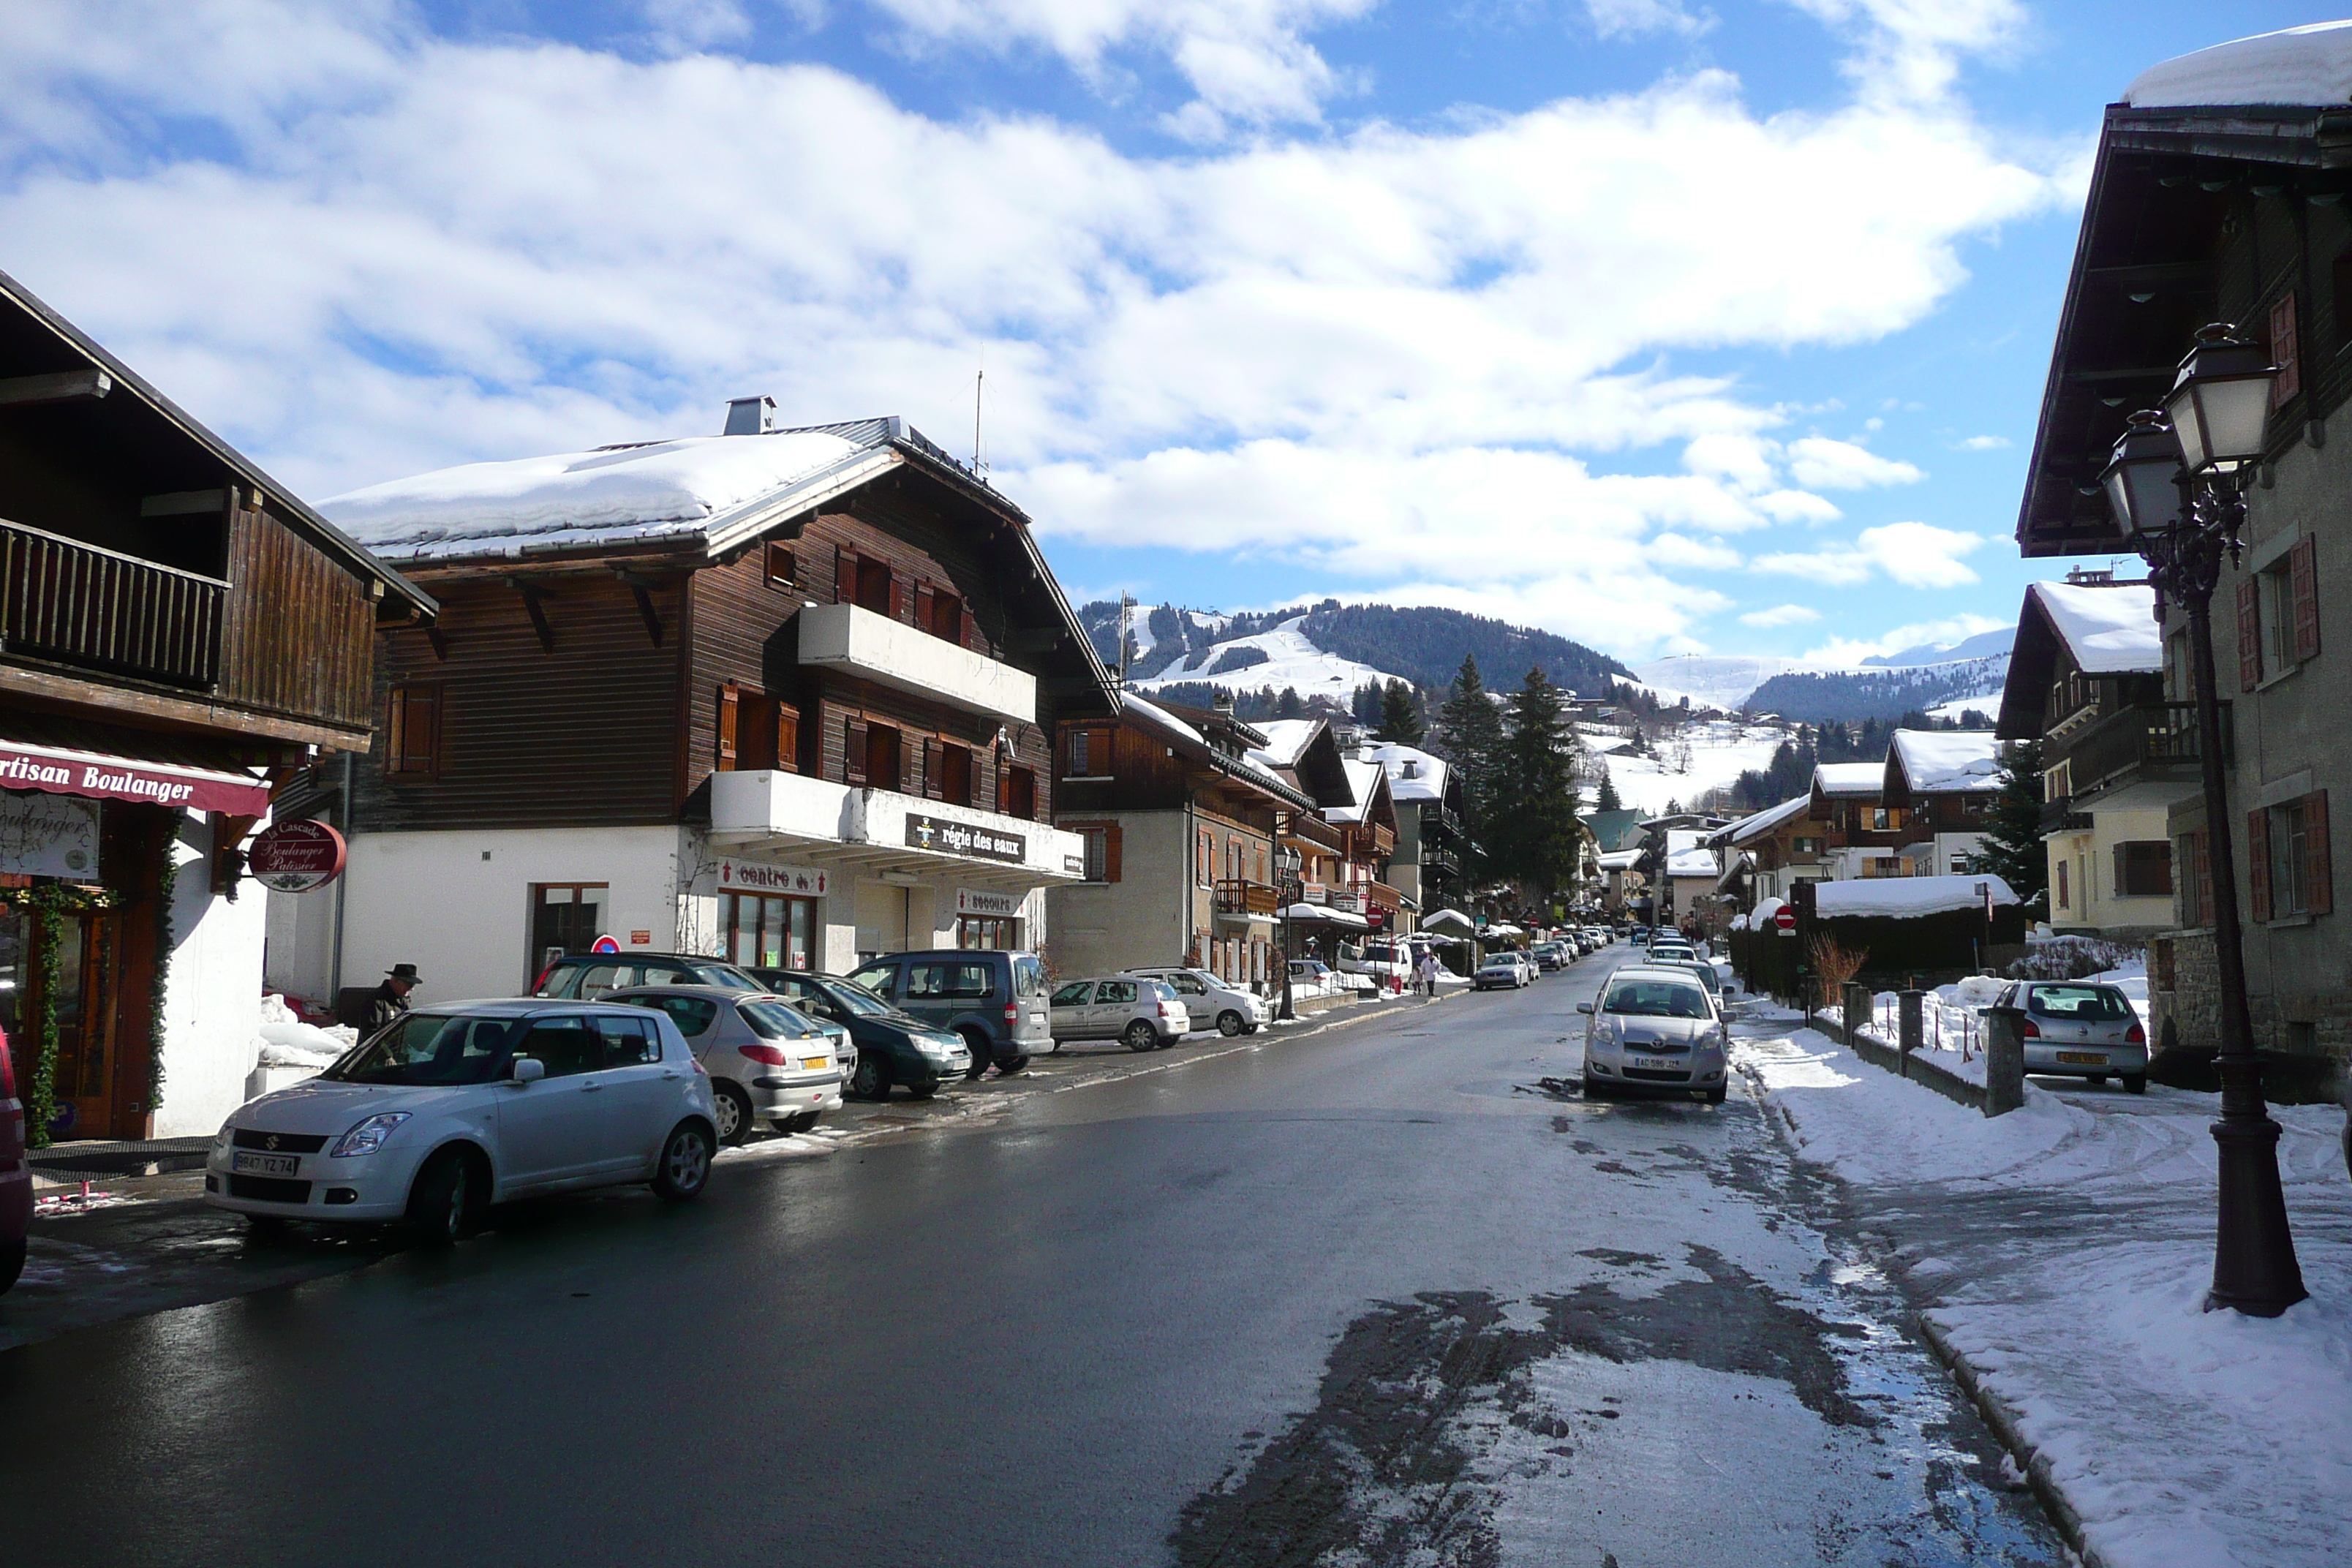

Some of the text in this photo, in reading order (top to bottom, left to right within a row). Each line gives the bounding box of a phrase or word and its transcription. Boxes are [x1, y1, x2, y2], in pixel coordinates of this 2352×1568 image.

[0, 757, 194, 802] rtisan Boulanger
[0, 804, 86, 844] oulanger
[266, 821, 320, 840] la Cascade
[943, 824, 971, 849] régie
[973, 831, 992, 851] des
[994, 838, 1019, 855] eaux
[261, 842, 325, 862] Boulanger
[740, 866, 790, 888] centre
[973, 894, 1010, 911] secours
[264, 1158, 276, 1172] YZ
[279, 1159, 293, 1172] 74
